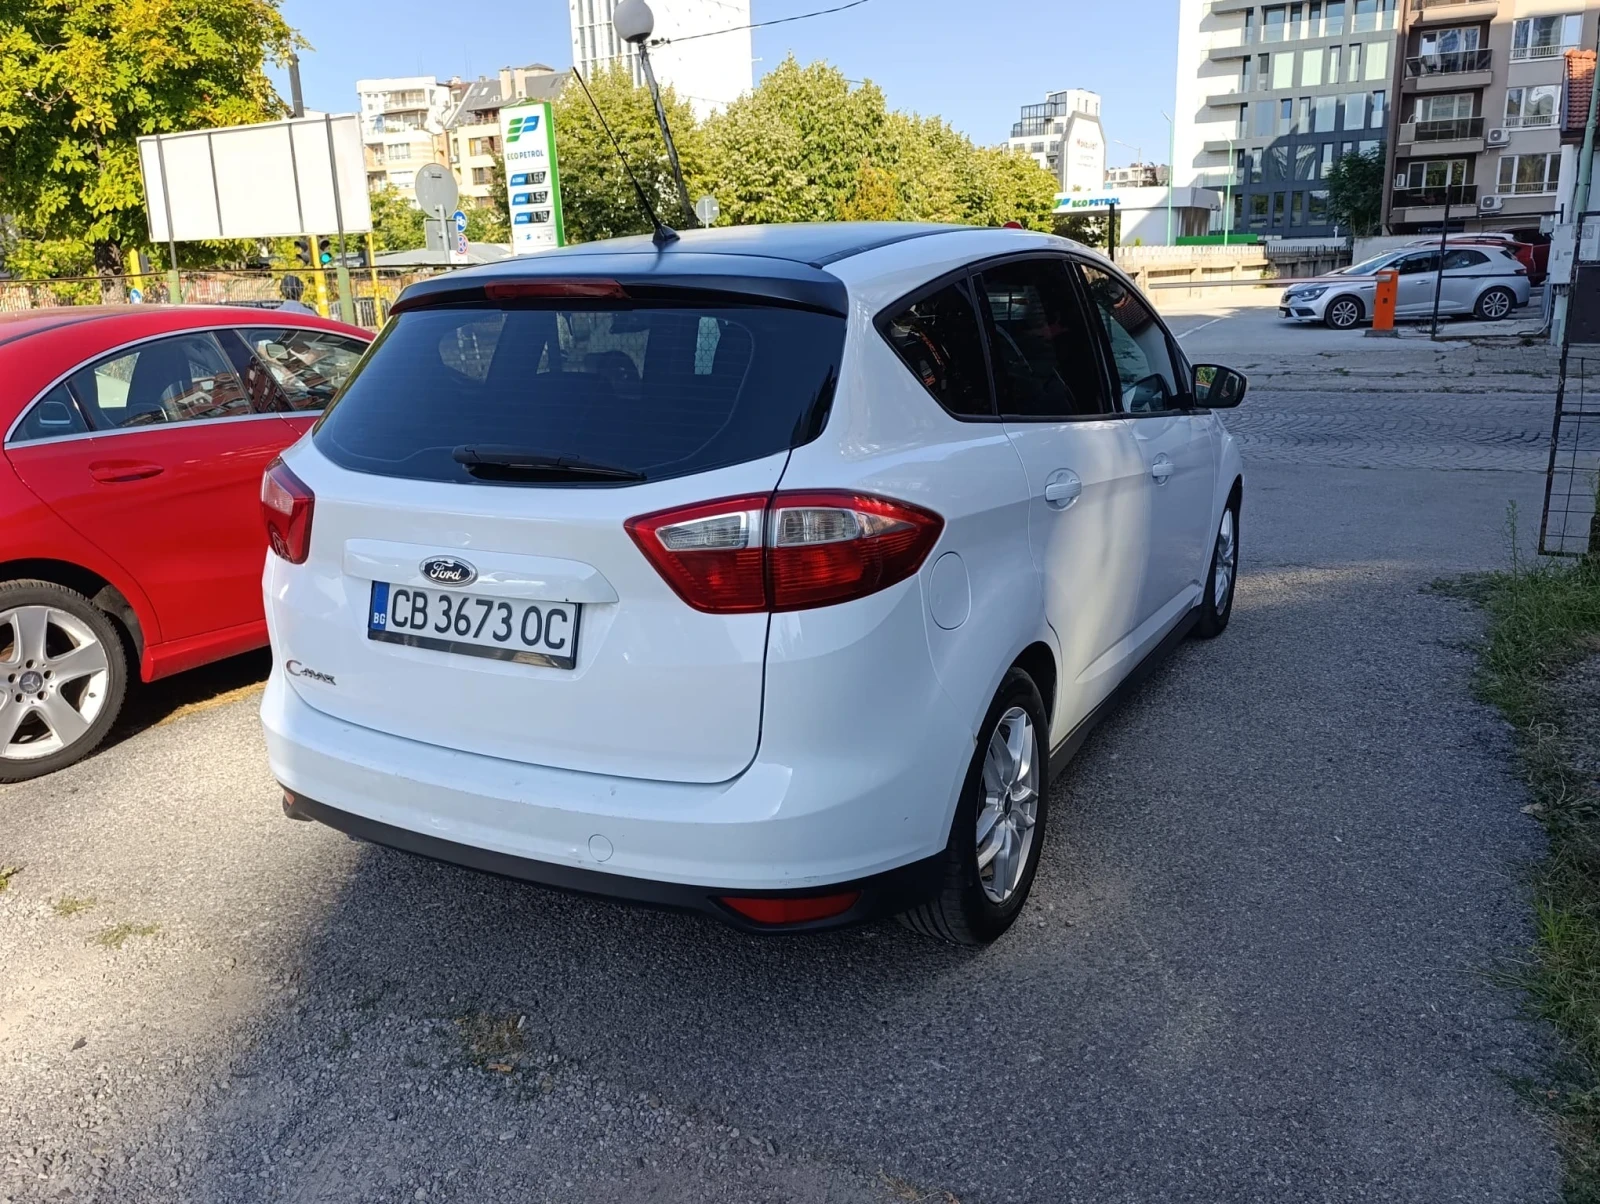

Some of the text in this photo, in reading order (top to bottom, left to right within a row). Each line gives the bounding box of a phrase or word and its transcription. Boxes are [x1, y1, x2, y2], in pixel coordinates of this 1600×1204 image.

[430, 560, 462, 581] Ford
[373, 612, 386, 625] BG
[391, 589, 428, 630] CB
[434, 594, 513, 642] 3673
